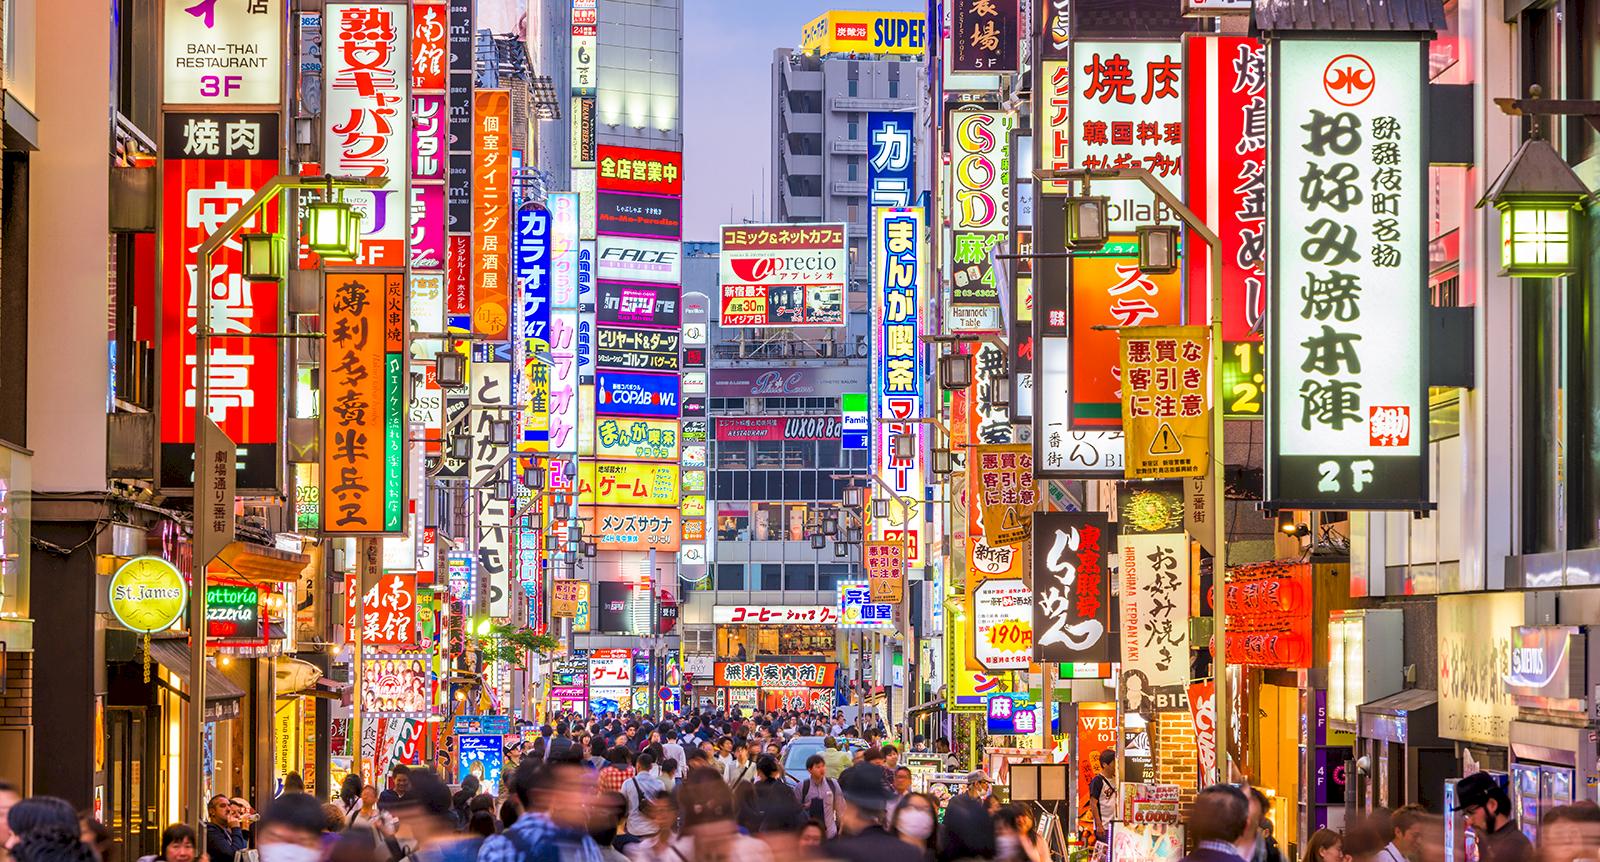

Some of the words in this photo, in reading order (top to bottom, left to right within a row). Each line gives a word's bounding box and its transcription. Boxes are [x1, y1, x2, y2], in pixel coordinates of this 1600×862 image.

[187, 44, 258, 54] BAN-THAI
[176, 57, 268, 68] RESTAURANT
[200, 75, 243, 97] 3F
[331, 7, 402, 179] 熟女キャバクラ
[183, 118, 260, 156] 焼肉
[417, 98, 439, 176] レンタル
[1082, 120, 1182, 146] 韓国料理
[600, 157, 677, 184] 全店営業中
[956, 113, 997, 228] GOD
[482, 116, 499, 288] 個室ダイニング居酒屋
[1371, 116, 1402, 268] 歌舞伎町名物
[724, 229, 843, 245] コミック&ネットカフェ
[520, 211, 547, 317] カラオケ
[600, 247, 678, 264] FACE
[780, 272, 834, 280] アプレシオ
[1299, 109, 1364, 431] お好み焼本陣
[724, 286, 766, 297] 新宿最大
[387, 282, 402, 342] 炭火串焼
[885, 217, 917, 395] まんが喫茶
[953, 307, 988, 317] Hammock
[724, 315, 766, 324] ハイジアB1
[960, 318, 981, 327] Table
[598, 330, 678, 352] ビリヤード&ダーツ
[1127, 340, 1203, 363] 悪質な
[531, 362, 547, 413] 麻雀
[1128, 367, 1203, 391] 客引き
[1130, 395, 1203, 418] に注意
[599, 420, 675, 448] まんが喫茶
[785, 417, 823, 438] LUXOR
[1048, 422, 1063, 468] 一番街
[982, 453, 1033, 469] 悪質な
[600, 476, 648, 497] ゲーム
[983, 472, 1033, 488] 客引き
[1318, 459, 1375, 493] 2F
[213, 450, 228, 533] 劇場通り一番街
[985, 489, 1035, 506] に注意
[602, 515, 672, 533] メンズサウナ
[869, 546, 900, 556] 悪質な
[869, 557, 900, 567] 客引き
[975, 543, 1011, 562] 新宿
[869, 569, 901, 578] に注意
[987, 562, 1000, 573] の
[1124, 546, 1137, 597] HIROSHIMA
[731, 607, 783, 622] コーヒー
[860, 604, 892, 620] 個室
[1143, 545, 1186, 672] お好み焼き
[593, 666, 629, 680] ゲーム
[724, 663, 817, 681] 無料案内所
[281, 732, 290, 777] Restaurant
